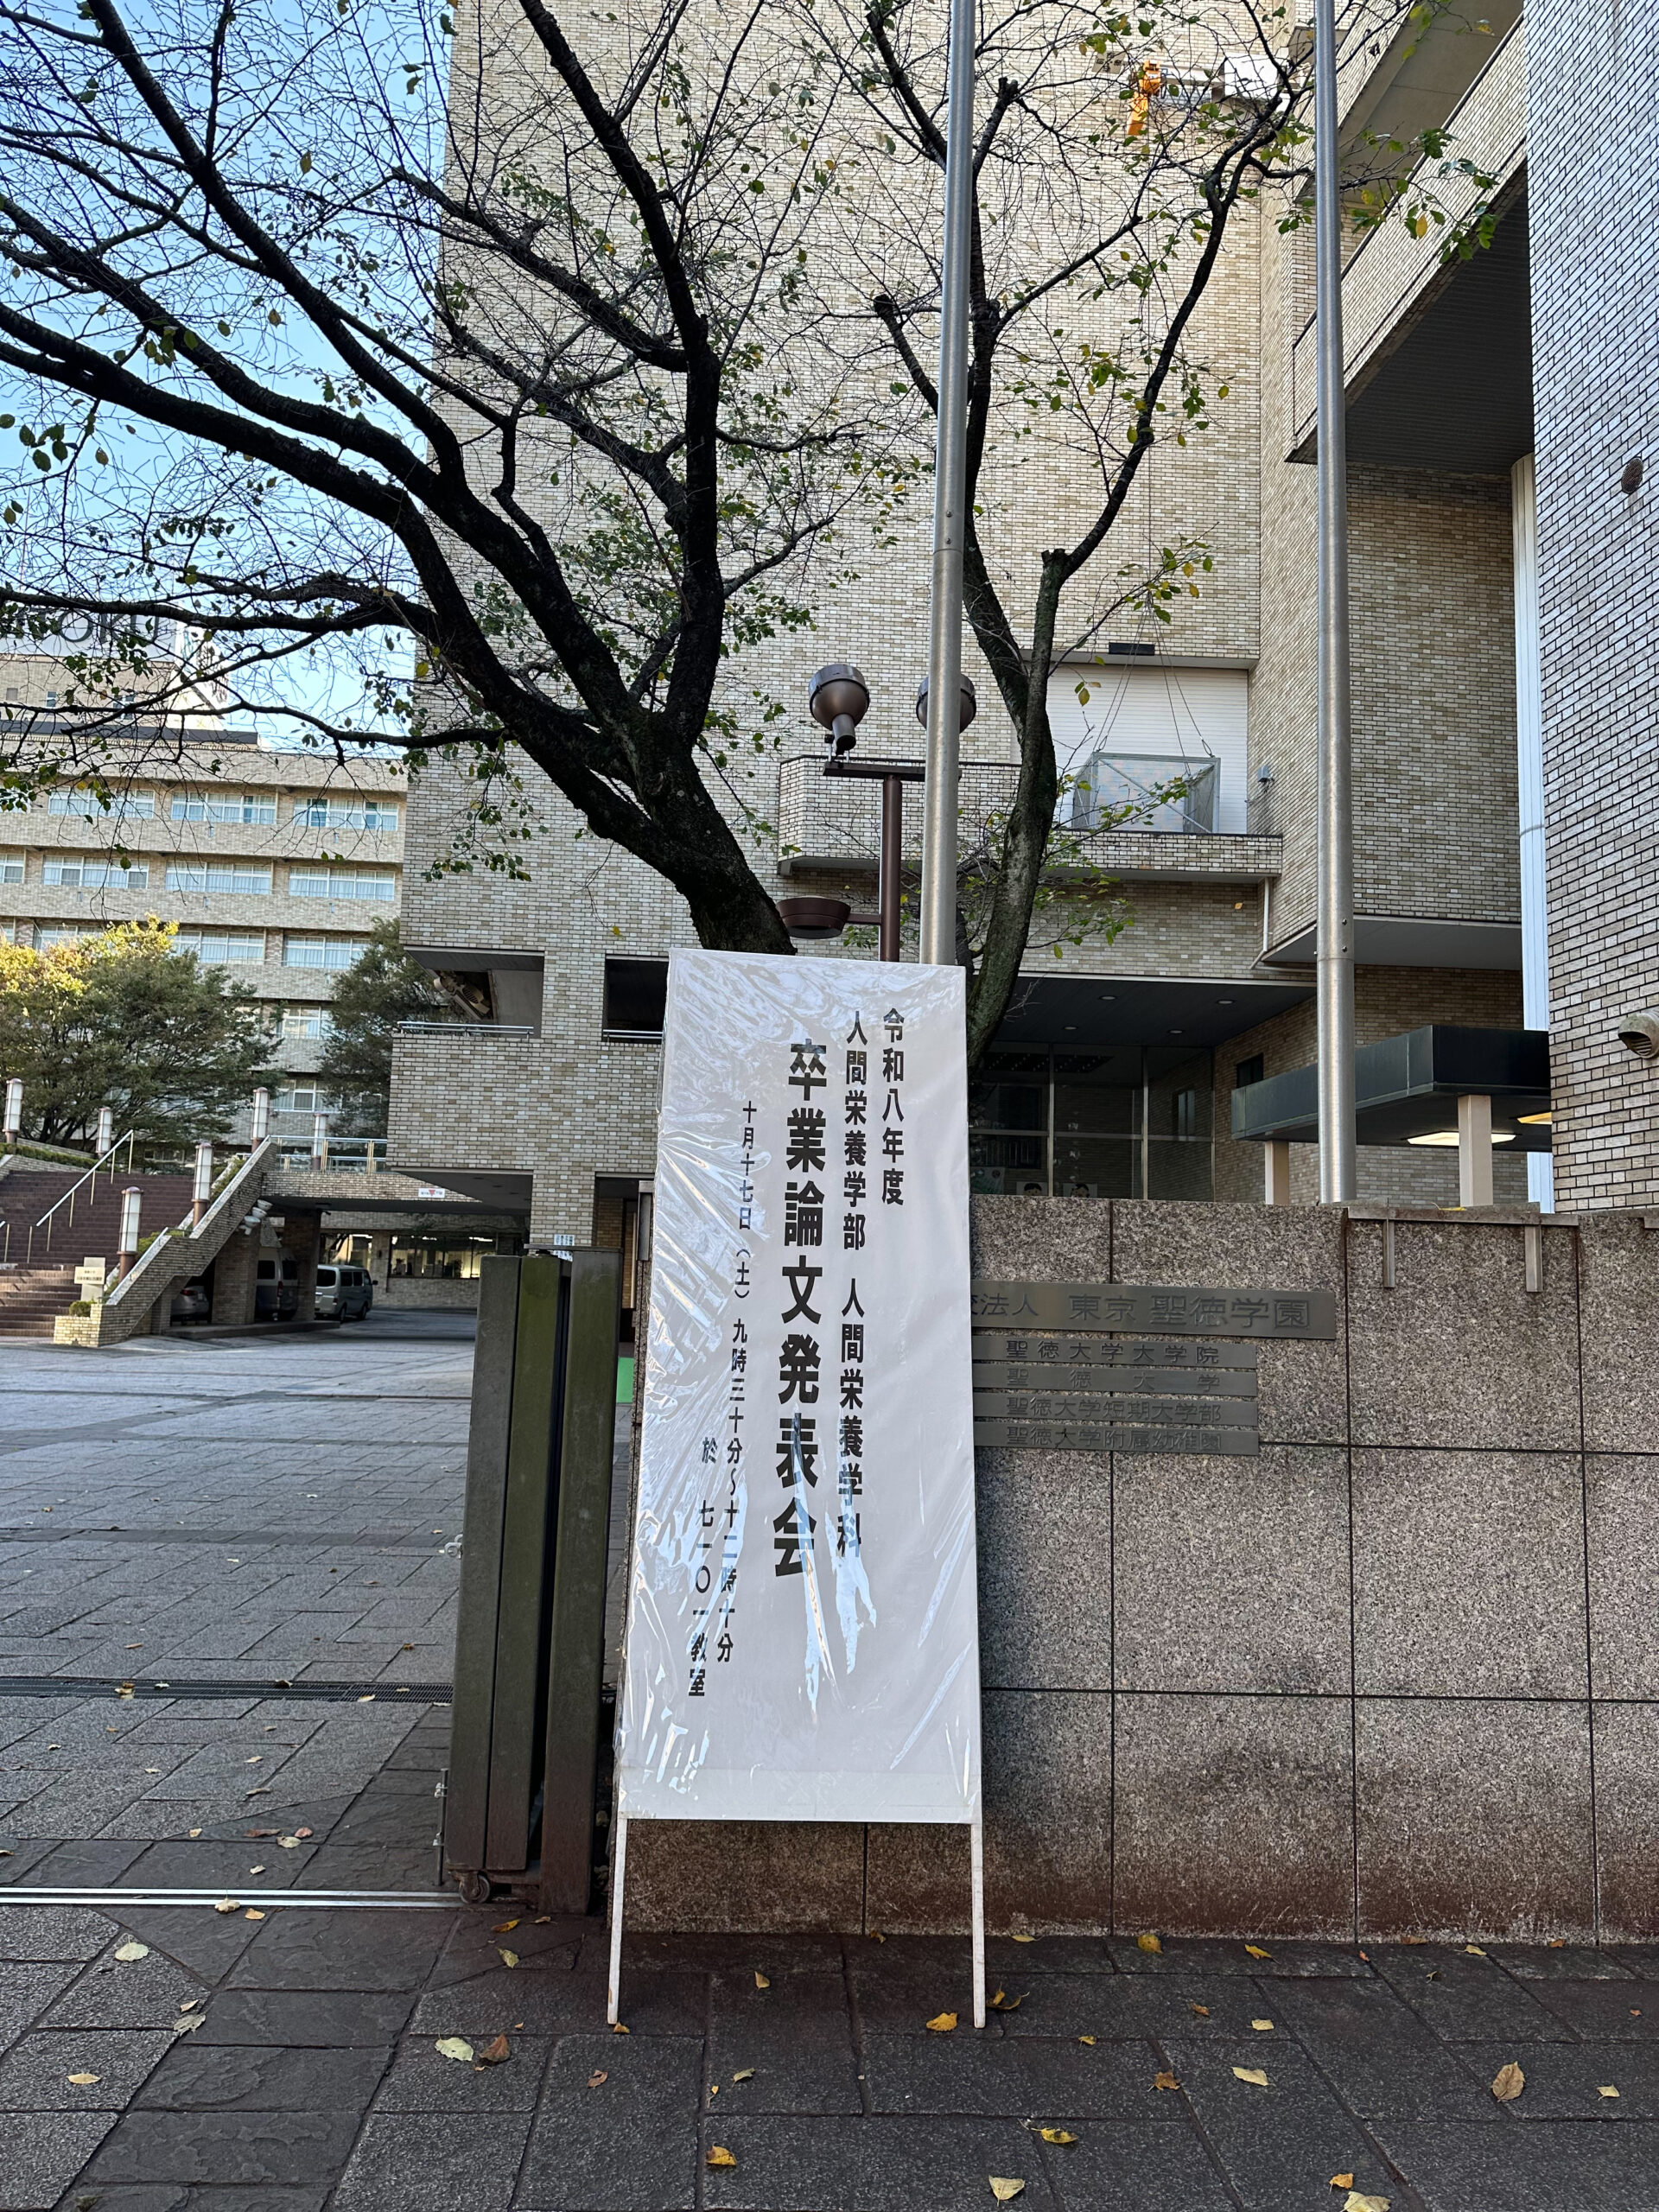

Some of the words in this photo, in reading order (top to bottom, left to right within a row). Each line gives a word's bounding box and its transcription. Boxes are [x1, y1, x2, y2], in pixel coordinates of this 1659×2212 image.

[842, 1010, 868, 1251] 人間栄養学部
[881, 1007, 905, 1206] 令和八年度
[772, 1038, 827, 1577] 卒業論文発表会
[836, 1277, 865, 1558] 人間栄養学科
[1005, 1339, 1219, 1365] 聖徳大学大学院
[1006, 1395, 1222, 1423] 聖徳大学短期大学部
